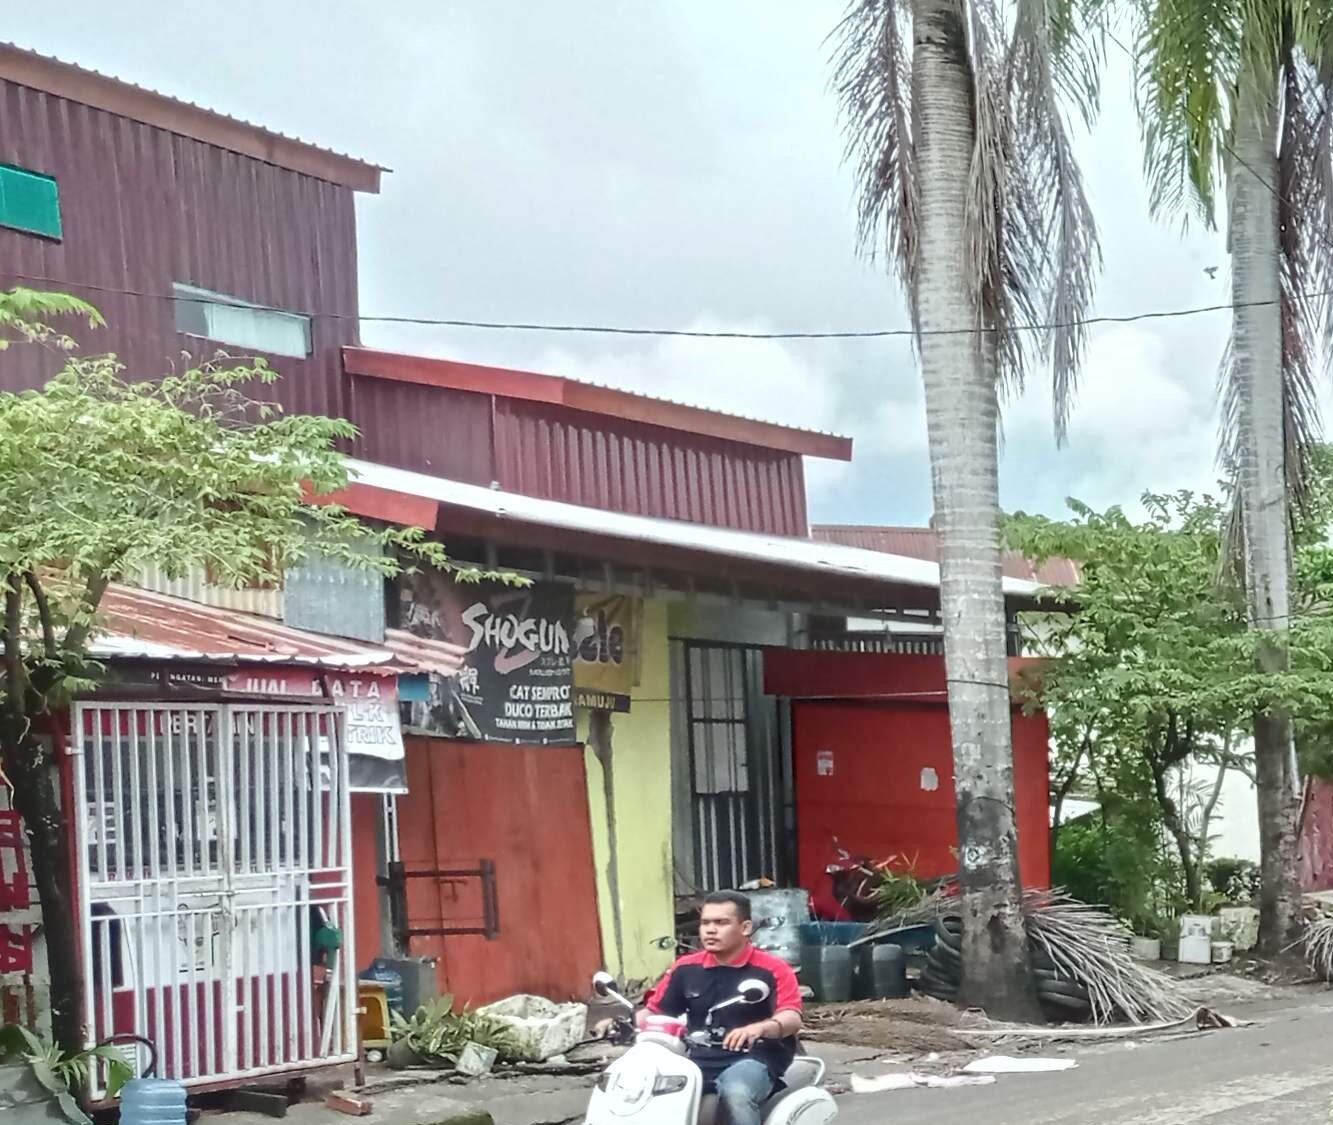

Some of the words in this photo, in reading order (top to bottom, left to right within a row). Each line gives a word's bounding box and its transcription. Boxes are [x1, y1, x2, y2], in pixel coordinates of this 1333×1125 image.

[462, 602, 570, 655] SHOGUN
[509, 685, 530, 700] CAT
[504, 702, 533, 718] DUCO
